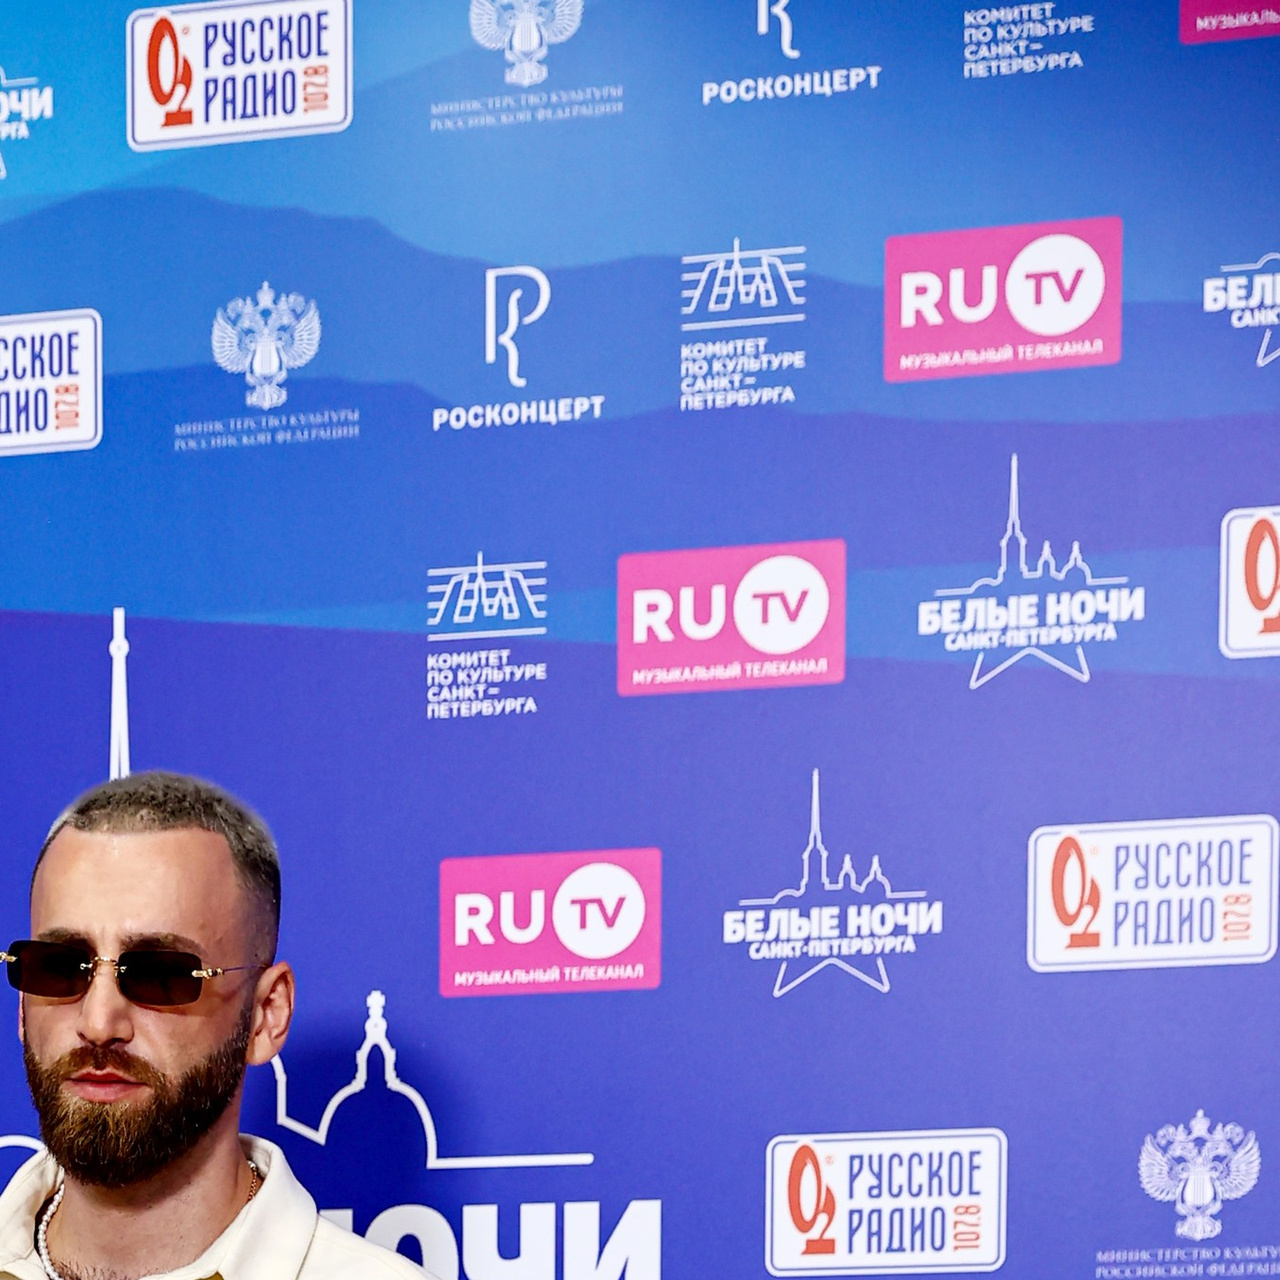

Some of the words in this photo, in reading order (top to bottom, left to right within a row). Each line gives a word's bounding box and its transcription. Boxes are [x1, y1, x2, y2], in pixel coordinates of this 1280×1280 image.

[203, 12, 329, 71] РУССКОЕ
[204, 70, 296, 124] РАДИО
[702, 66, 882, 105] РОСКОНЦЕРТ
[901, 265, 997, 327] RU
[1024, 268, 1084, 307] TV
[1203, 273, 1280, 313] БЕЛ
[433, 395, 605, 433] РОСКОНЦЕРТ
[633, 585, 726, 643] RU
[752, 589, 810, 626] TV
[919, 595, 1039, 633] БЕЛЫЕ
[1046, 588, 1145, 625] НОЧИ
[1114, 838, 1253, 892] РУССКОЕ
[455, 890, 545, 945] RU
[570, 895, 626, 931] TV
[723, 907, 840, 942] БЕЛЫЕ
[846, 902, 942, 936] НОЧИ
[1114, 896, 1215, 947] РАДИО
[848, 1150, 982, 1200] РУССКОЕ
[848, 1206, 945, 1254] РАДИО
